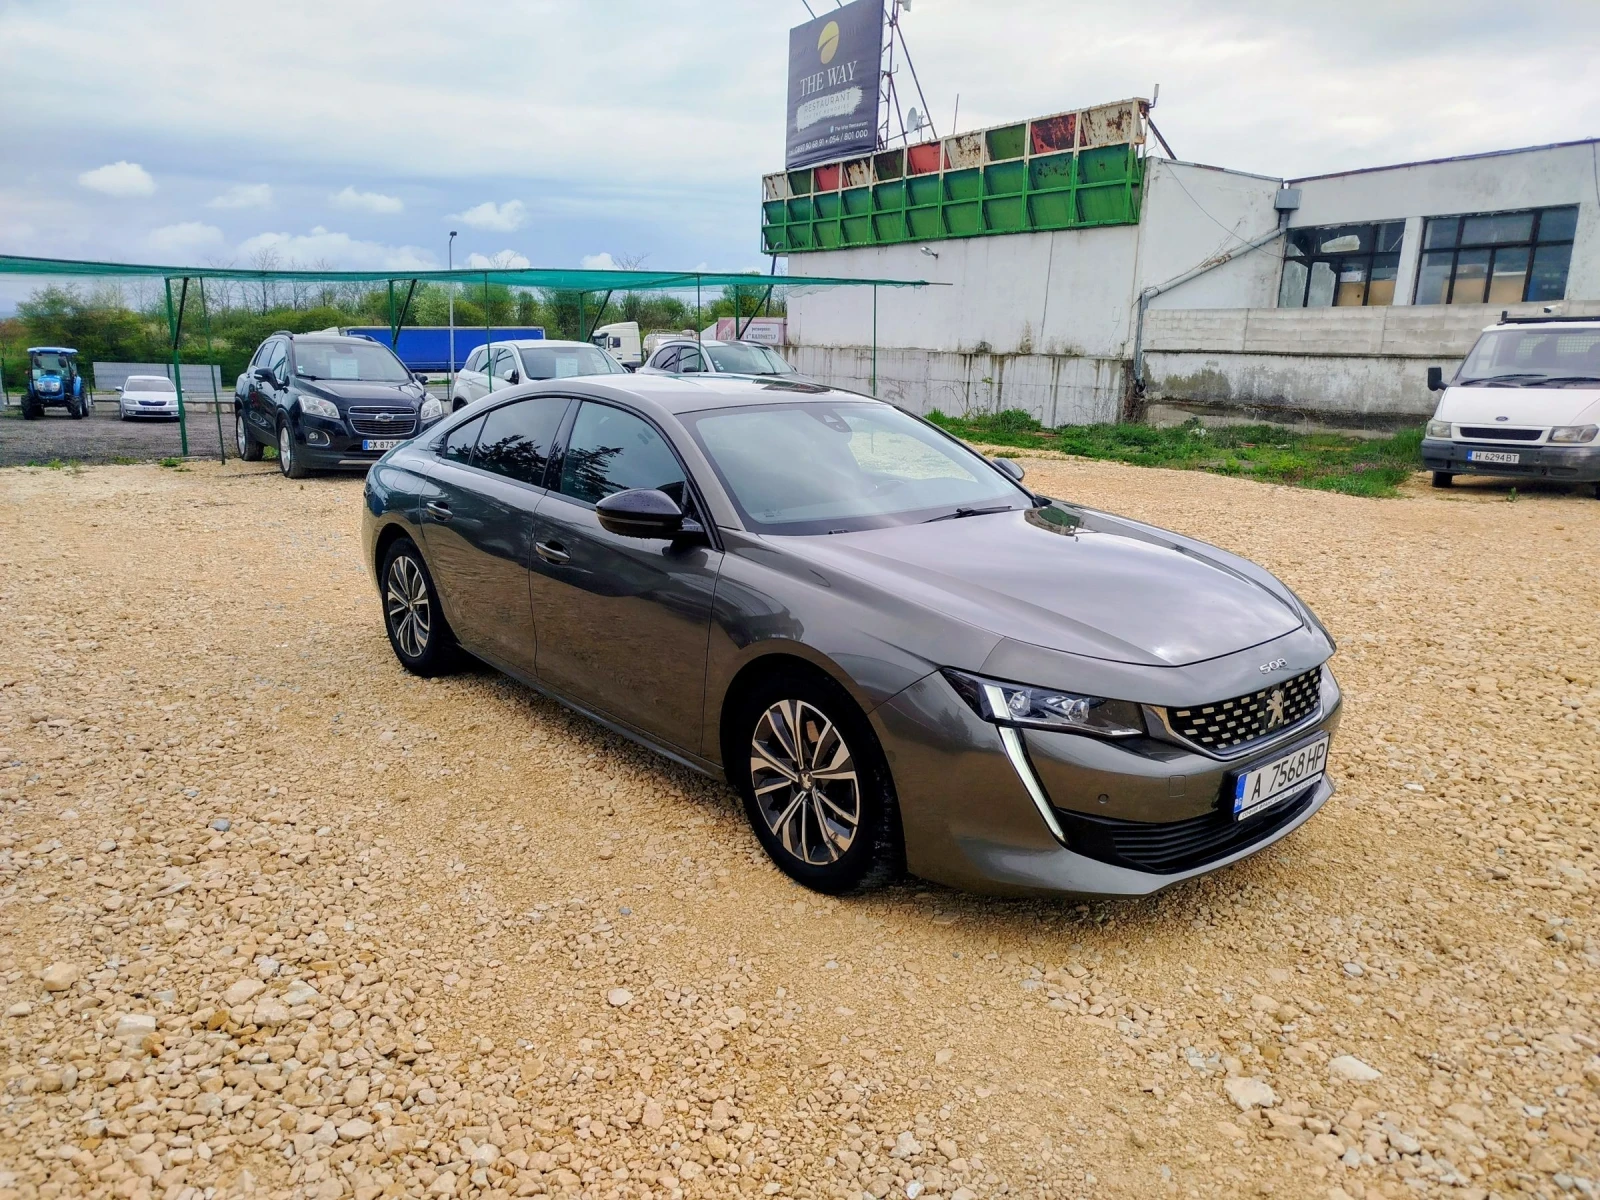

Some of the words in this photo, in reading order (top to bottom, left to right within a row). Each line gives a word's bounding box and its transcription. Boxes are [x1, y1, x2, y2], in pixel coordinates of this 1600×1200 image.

[800, 71, 824, 96] THE
[827, 60, 857, 86] WAY
[804, 92, 850, 112] RESTAURANT
[829, 135, 840, 144] 054
[844, 132, 854, 141] 801
[855, 129, 868, 139] 000
[1260, 657, 1287, 674] 508
[1251, 773, 1261, 801] A
[1234, 797, 1243, 808] BG
